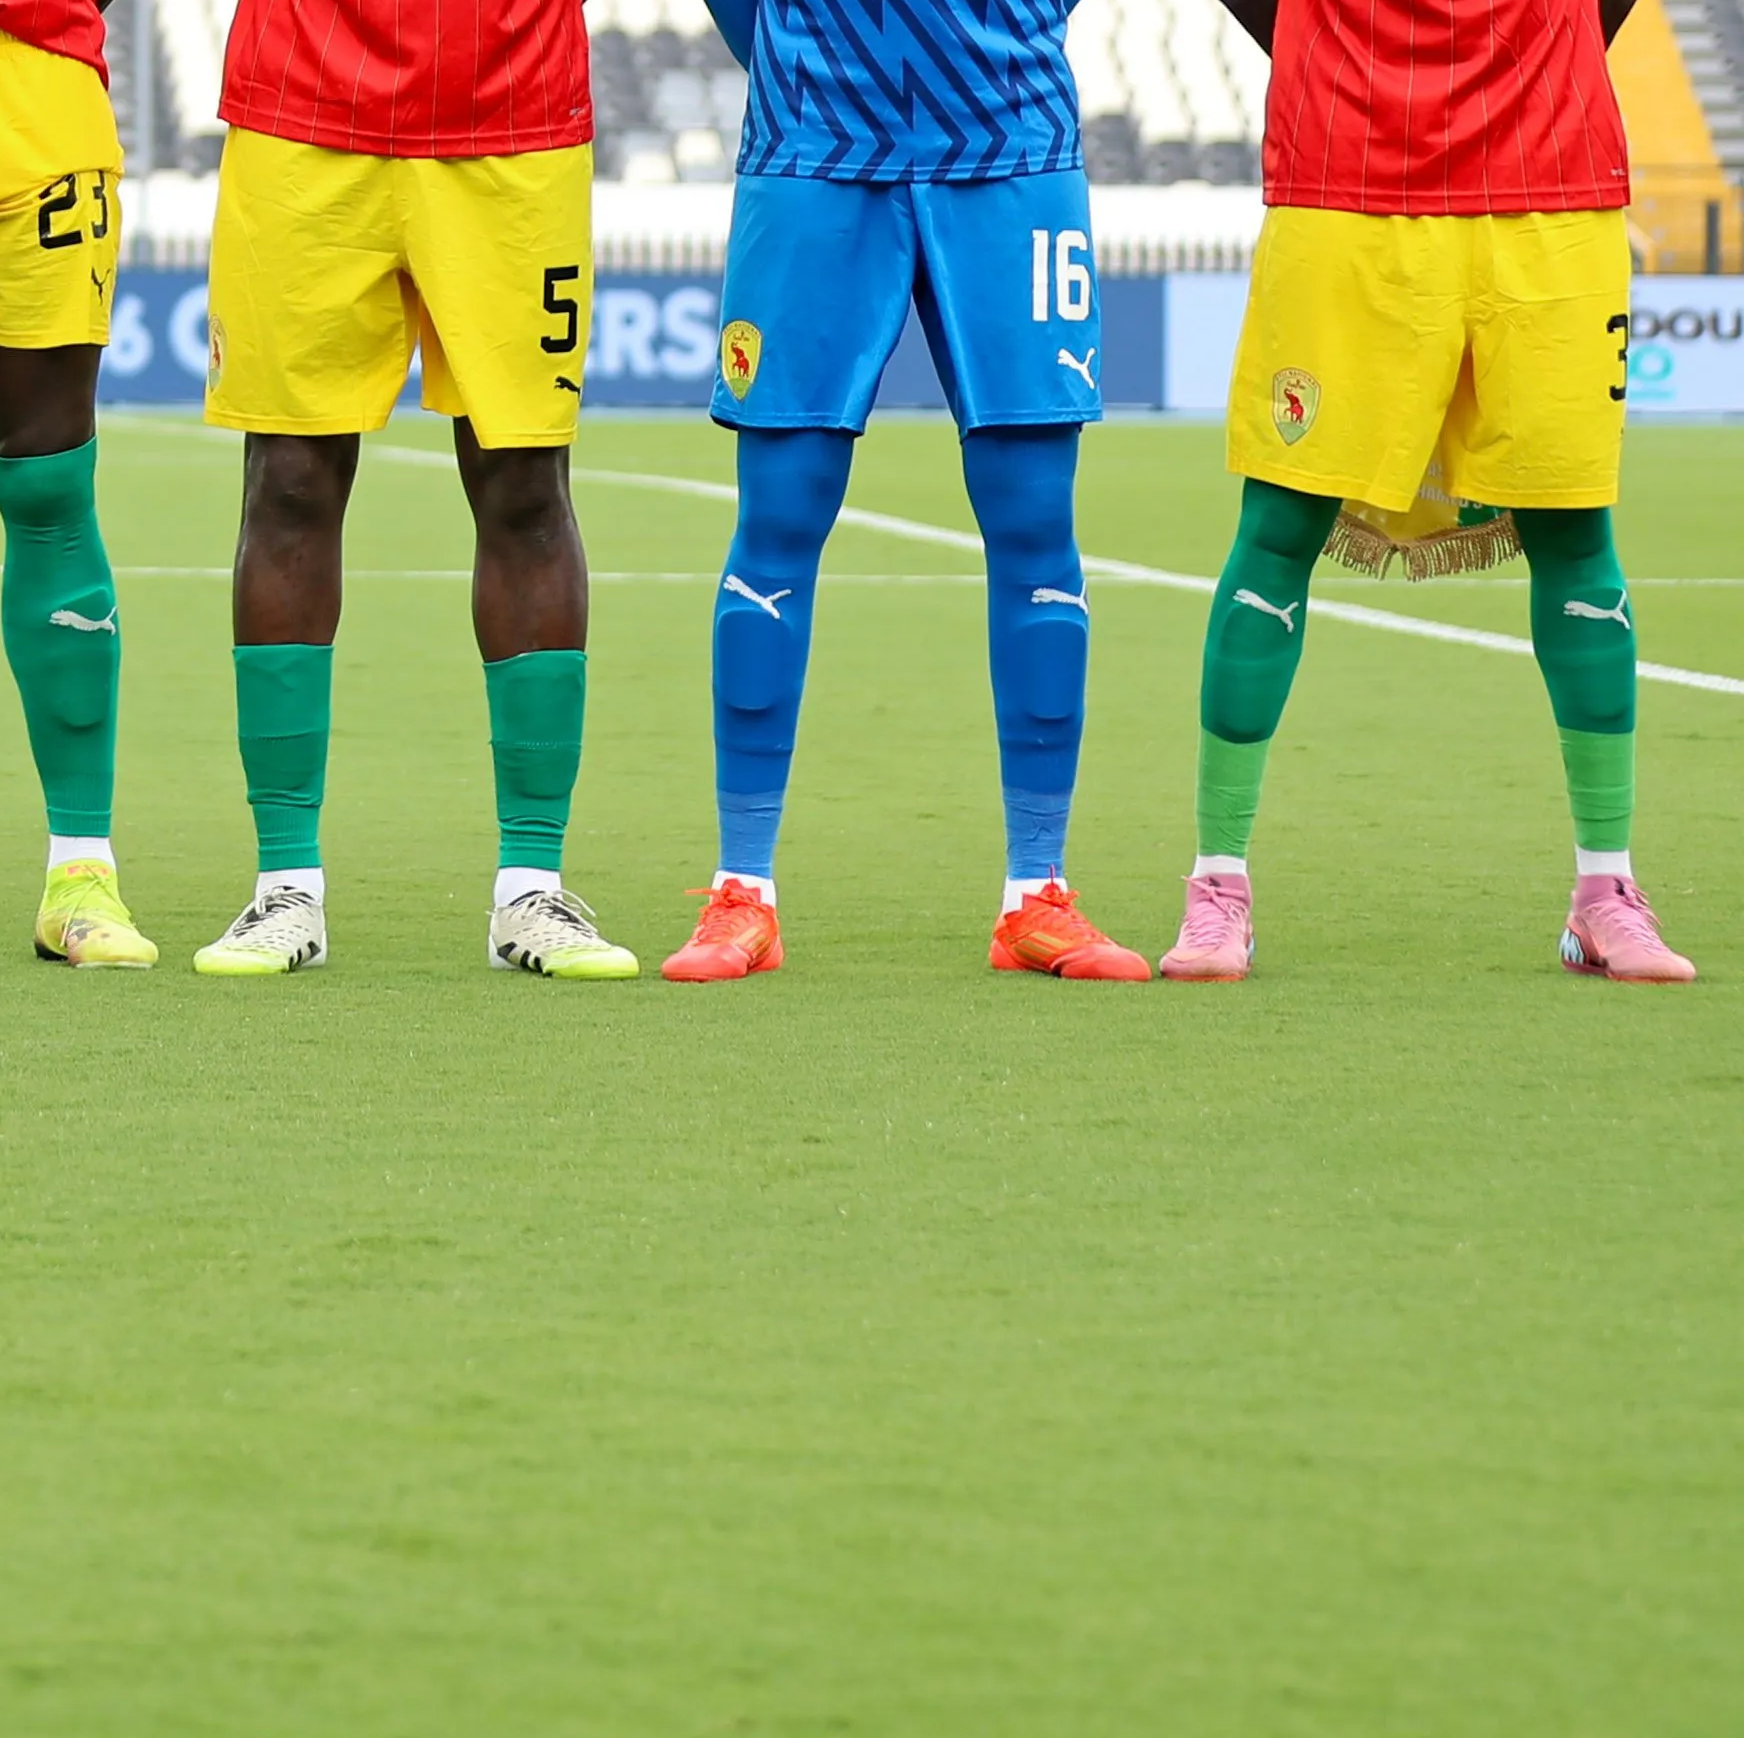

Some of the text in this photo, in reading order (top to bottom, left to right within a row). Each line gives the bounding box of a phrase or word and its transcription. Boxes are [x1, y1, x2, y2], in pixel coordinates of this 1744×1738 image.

[38, 169, 109, 250] 23
[540, 265, 579, 354] 5
[1032, 229, 1091, 322] 16
[1606, 313, 1629, 402] 3
